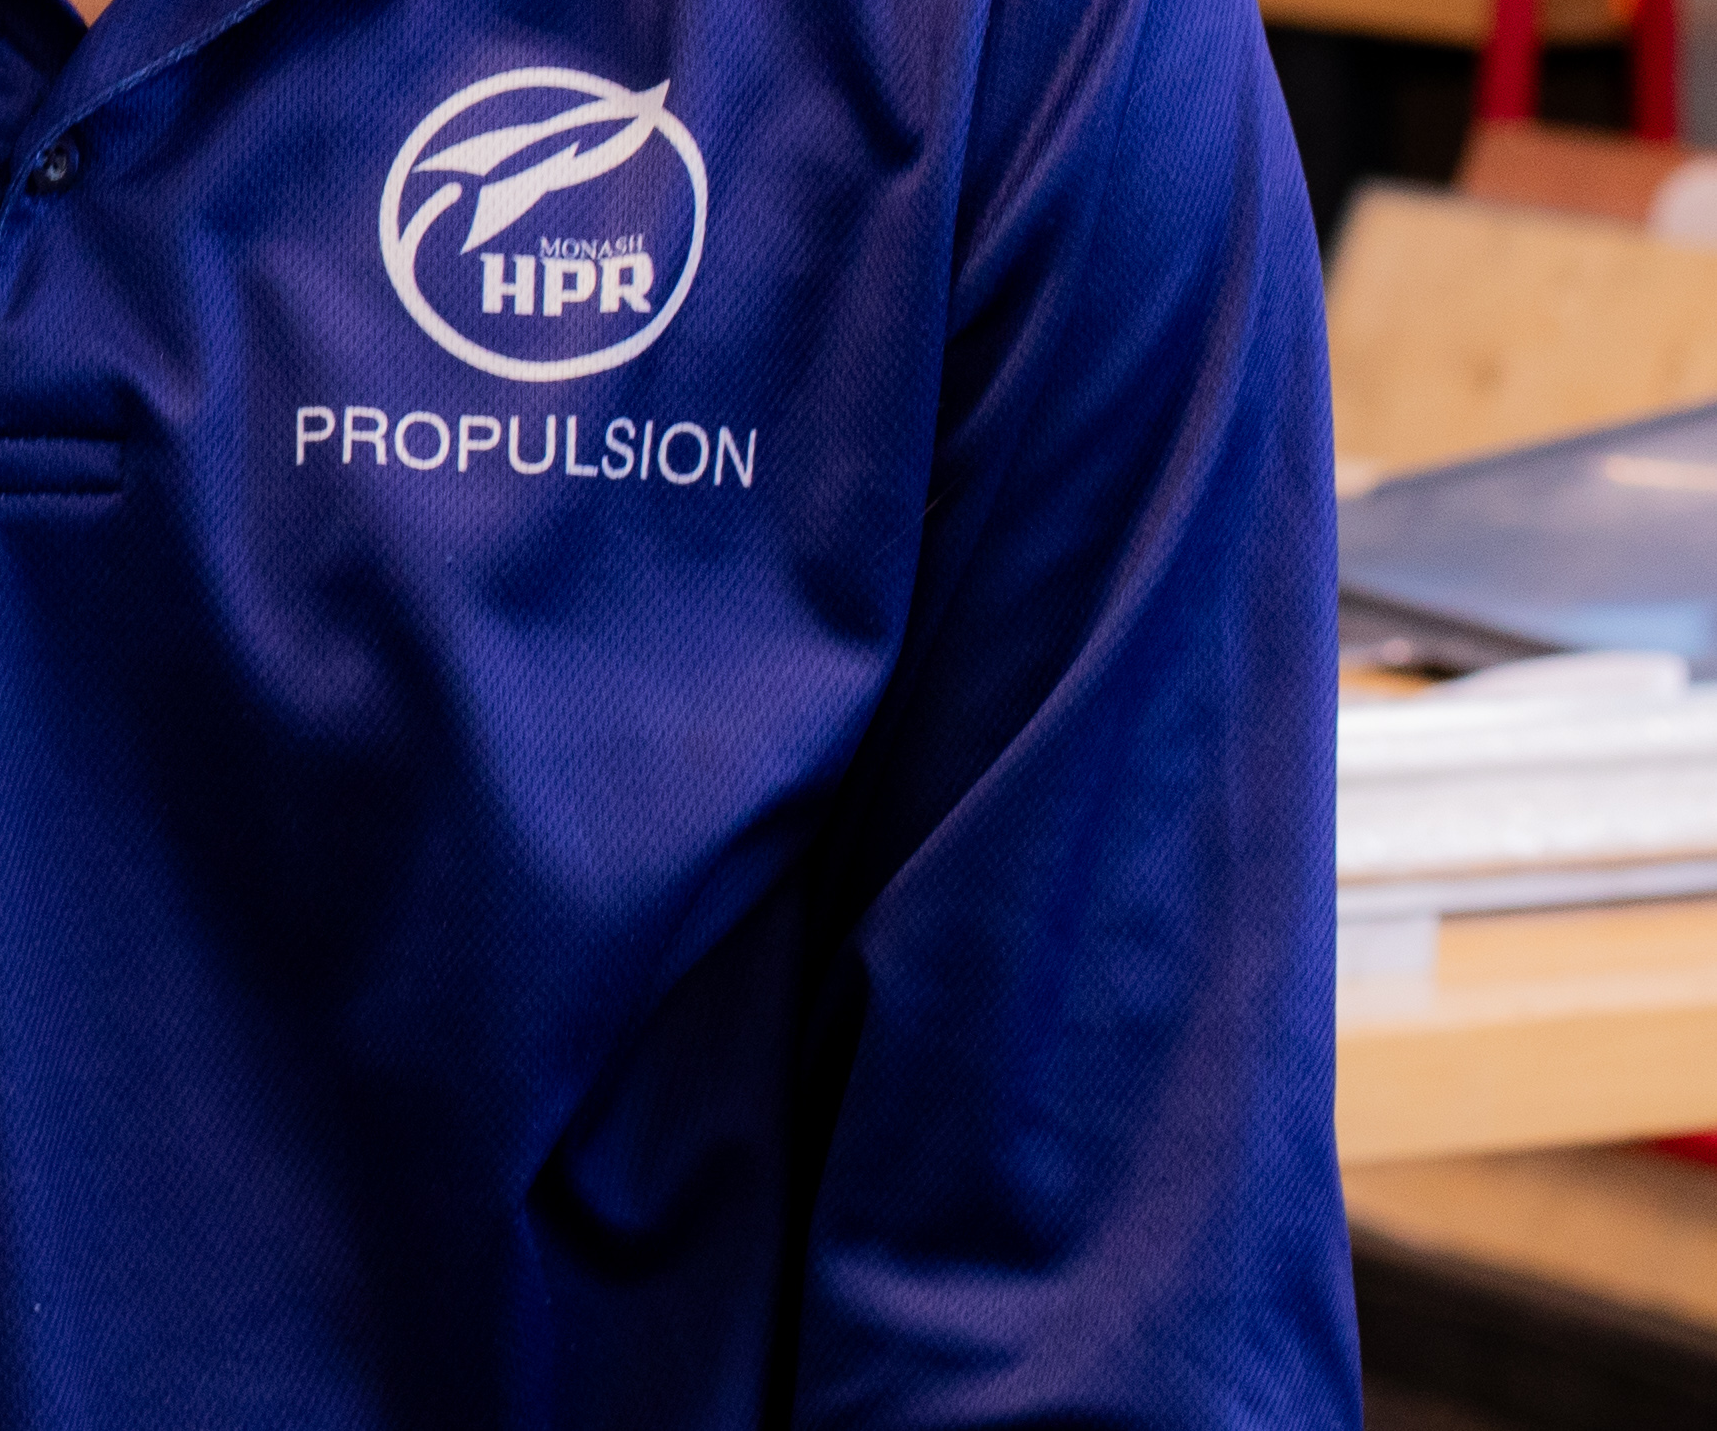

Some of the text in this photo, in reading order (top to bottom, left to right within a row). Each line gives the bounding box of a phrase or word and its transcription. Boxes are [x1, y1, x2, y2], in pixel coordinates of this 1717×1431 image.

[539, 232, 645, 260] MONASH
[479, 251, 655, 317] HPR
[295, 405, 757, 489] PROPULSION
